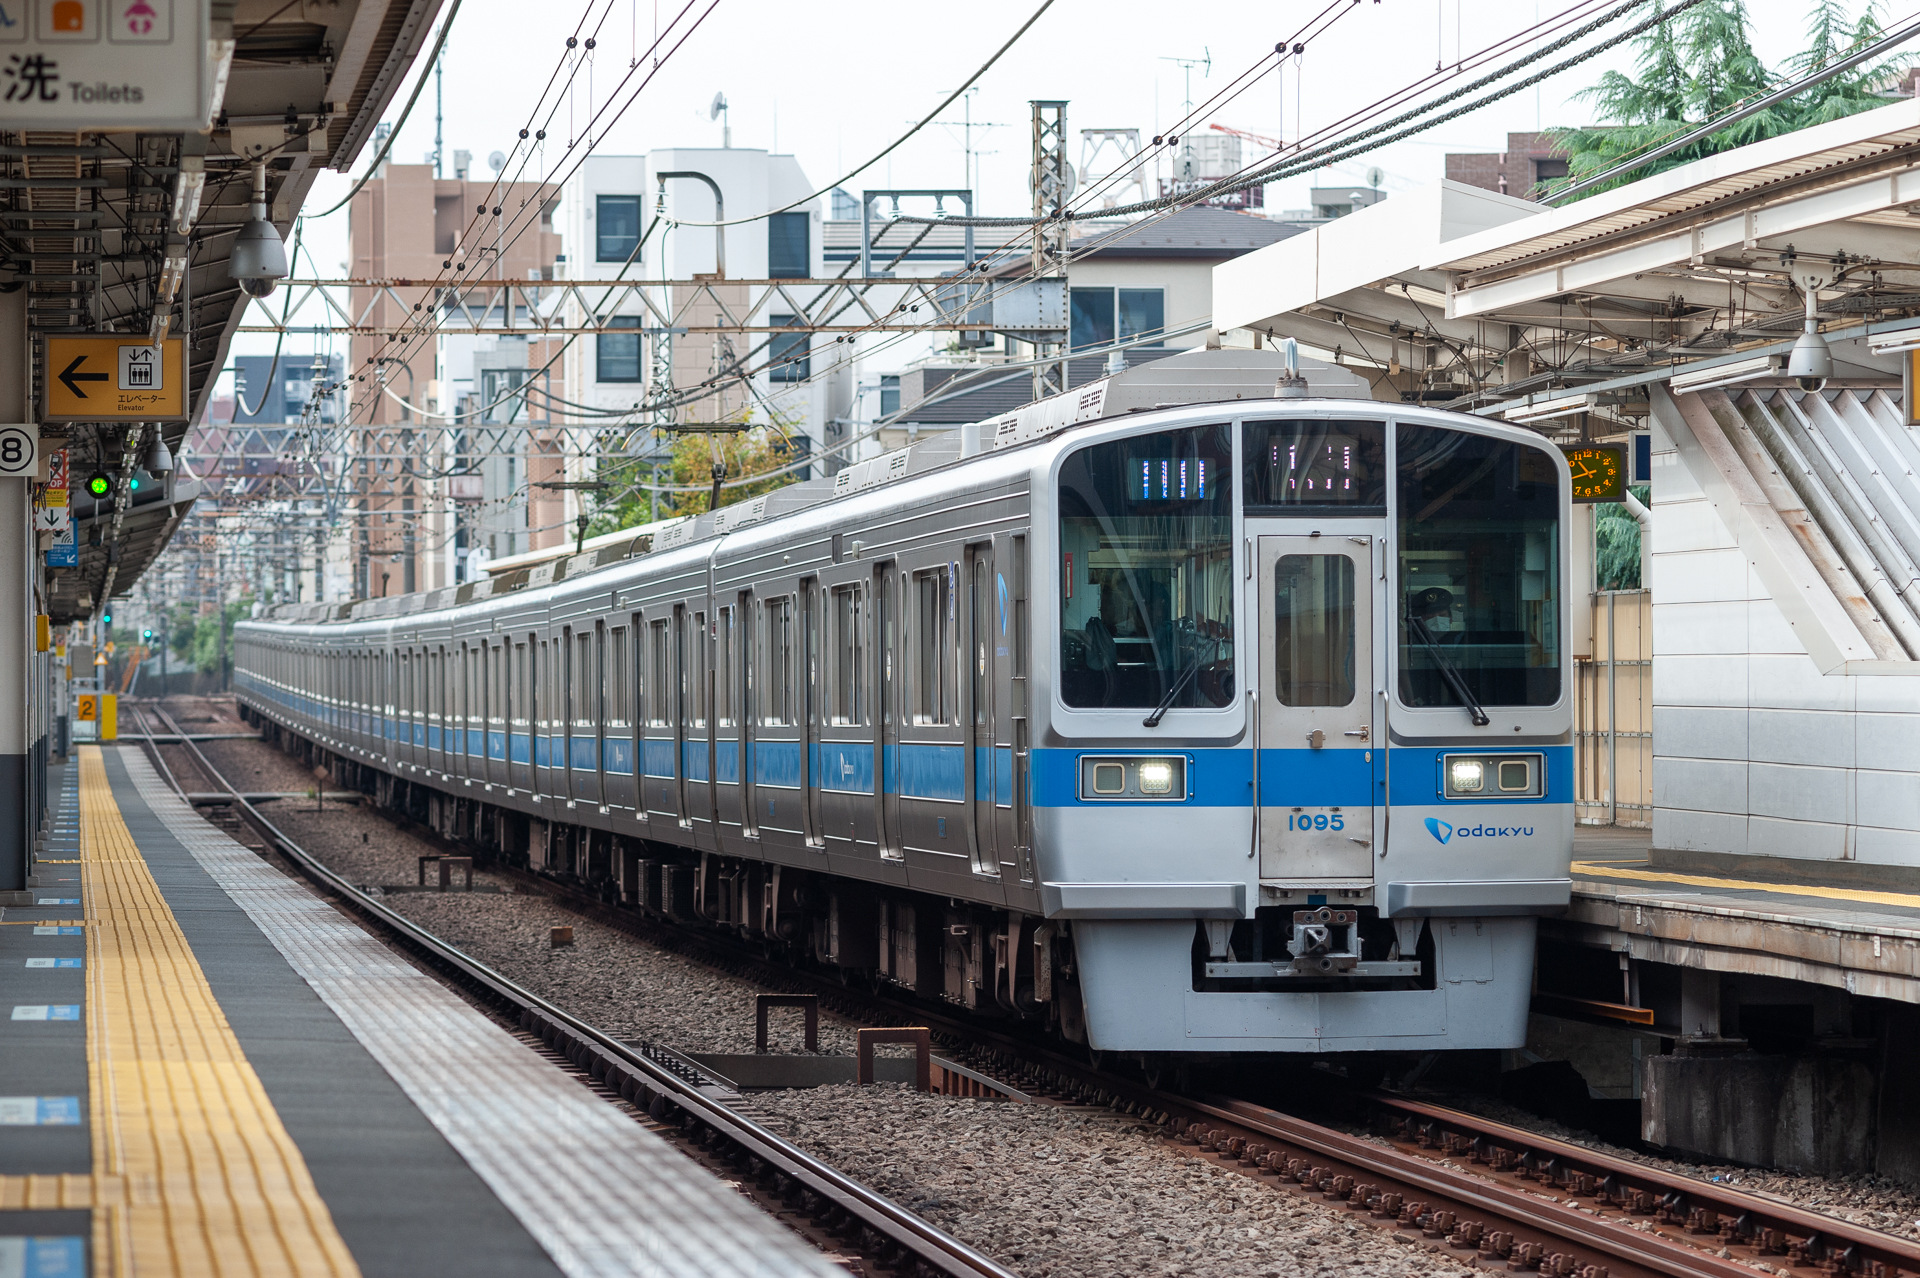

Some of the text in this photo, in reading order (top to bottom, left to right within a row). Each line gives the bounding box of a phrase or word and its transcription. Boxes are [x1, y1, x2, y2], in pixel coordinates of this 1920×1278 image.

[68, 81, 144, 103] Toilets
[118, 394, 166, 403] エレベーター
[1, 437, 22, 463] 8
[1583, 450, 1592, 458] 12
[1574, 452, 1582, 461] 11
[1602, 458, 1610, 466] 2
[1607, 468, 1614, 476] 3
[1575, 486, 1582, 494] 7
[1584, 487, 1592, 495] 6
[1594, 485, 1601, 493] 5
[82, 700, 93, 716] 2
[1289, 814, 1345, 832] 1095
[1457, 823, 1534, 838] odakyu
